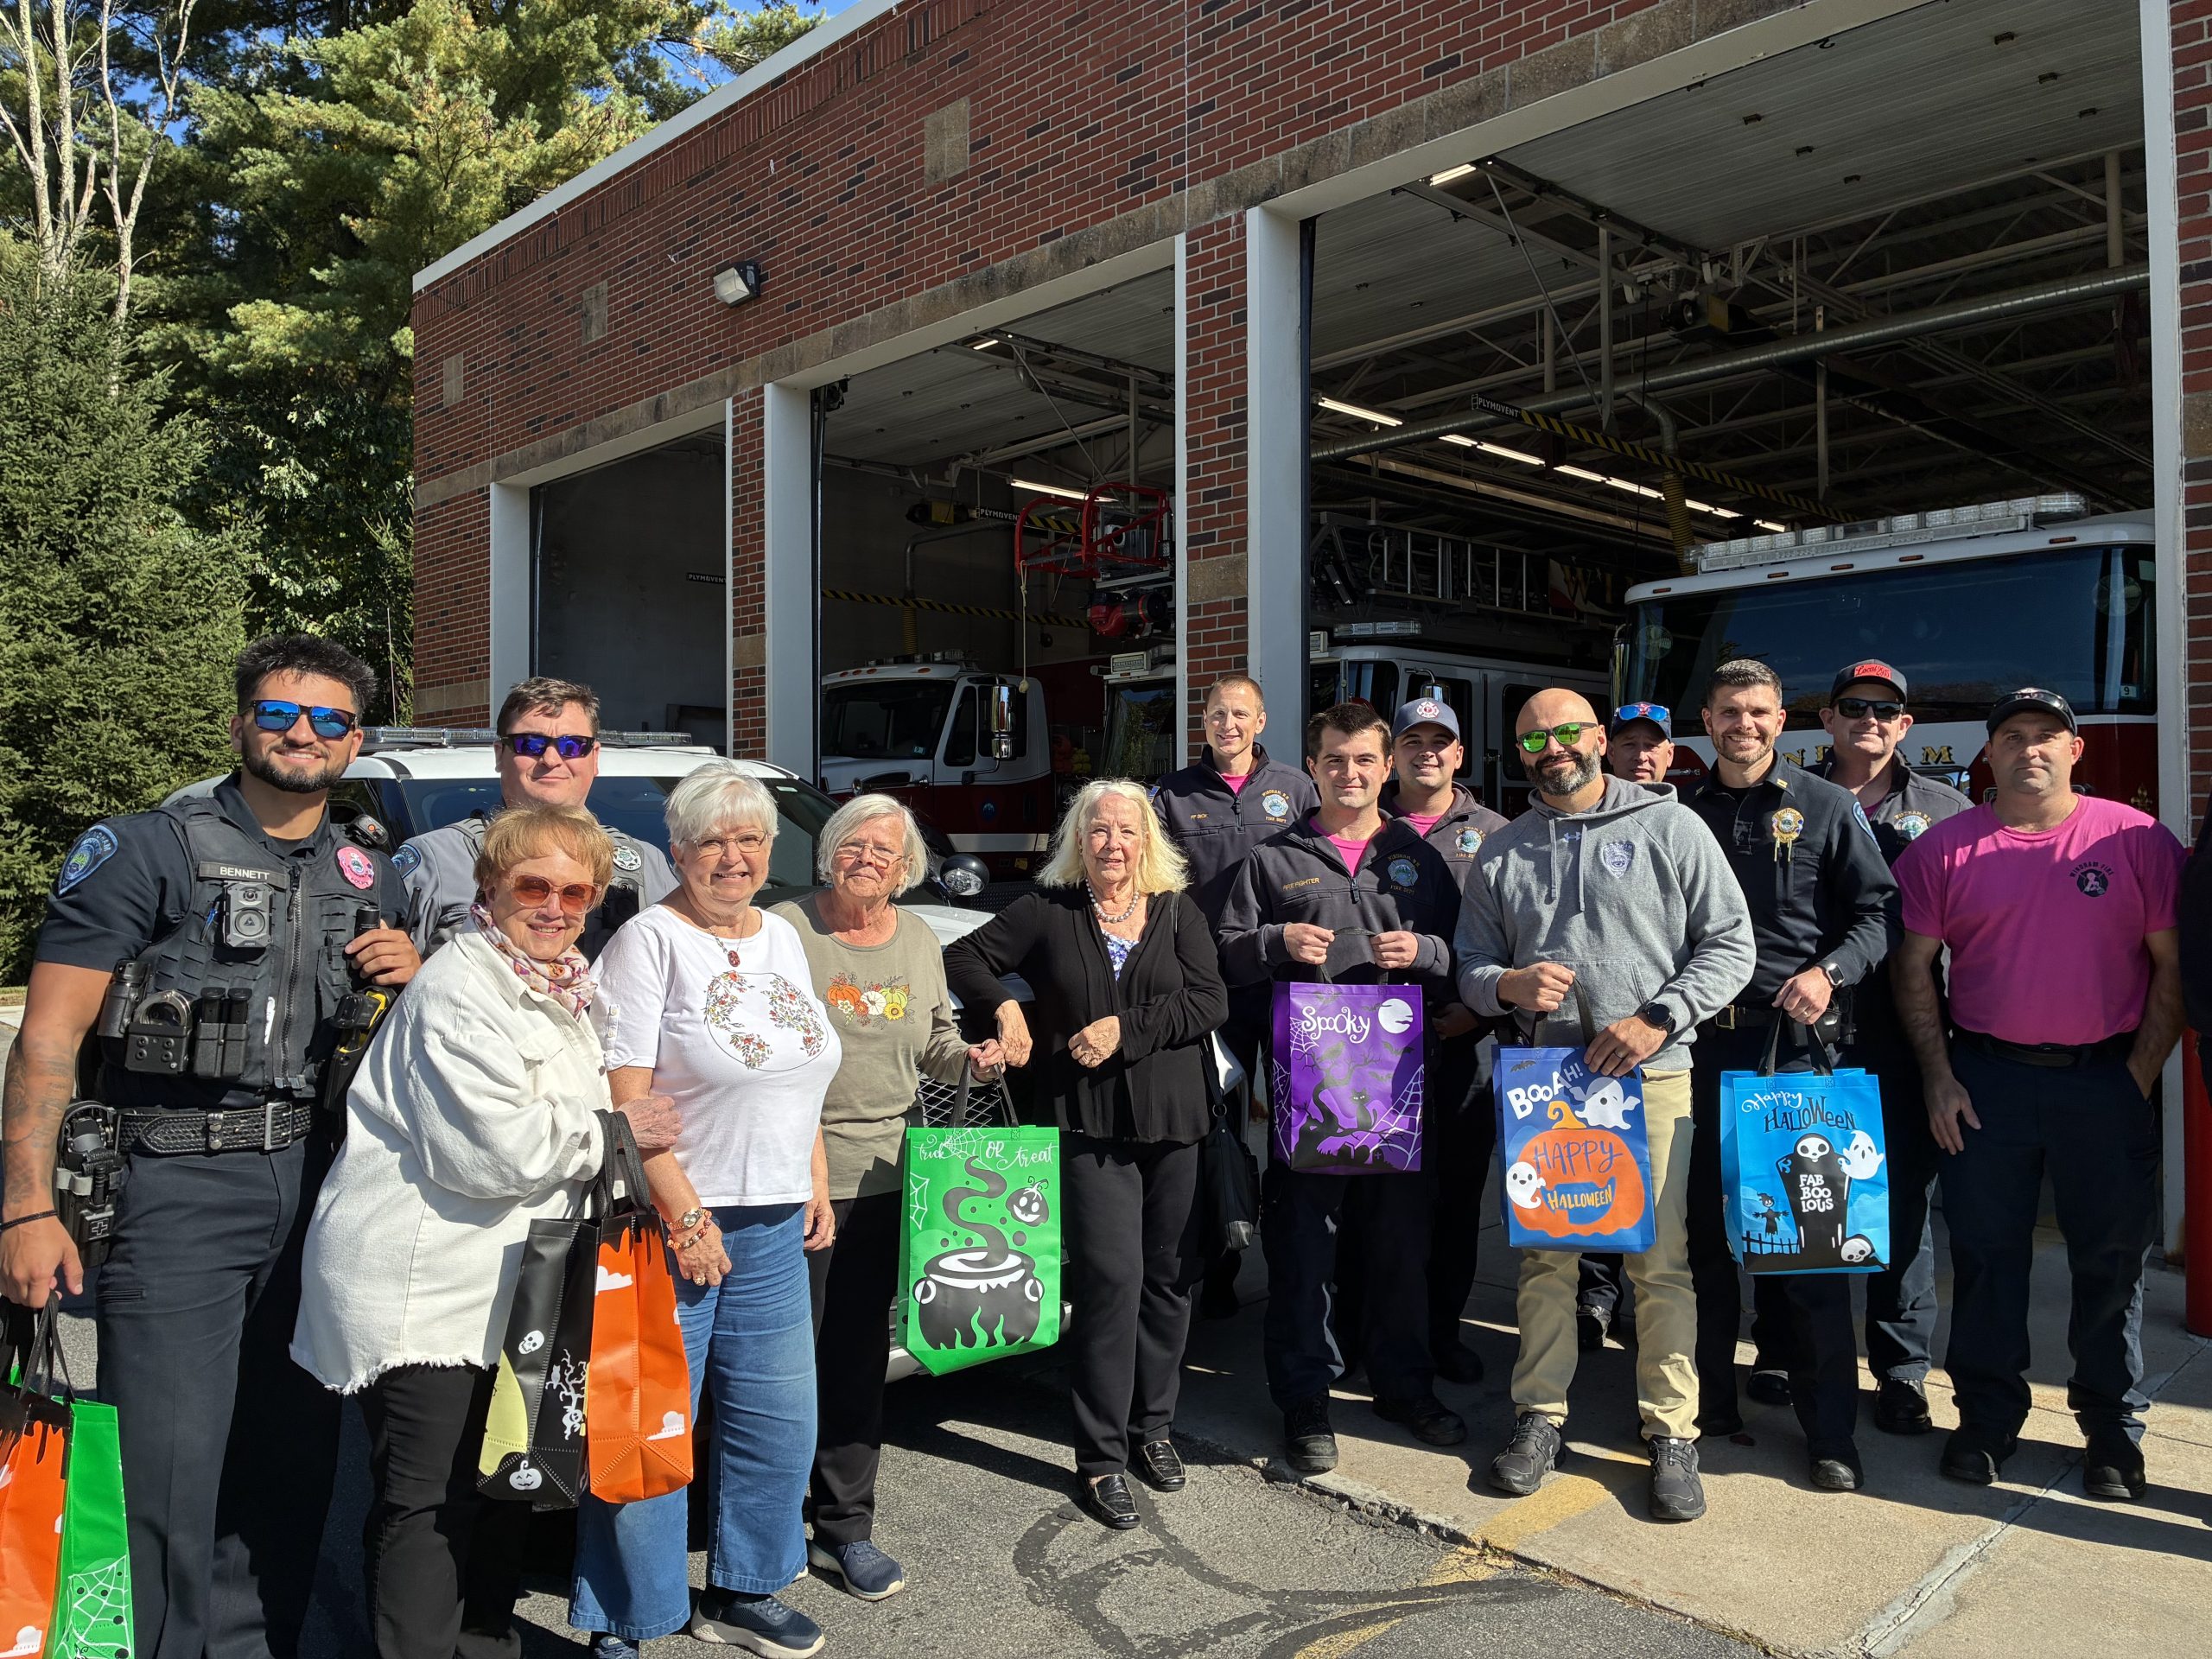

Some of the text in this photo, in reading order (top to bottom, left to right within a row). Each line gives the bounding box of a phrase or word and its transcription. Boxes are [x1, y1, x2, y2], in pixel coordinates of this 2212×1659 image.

[1478, 397, 1519, 418] PLYMOVENT
[2123, 686, 2130, 696] 9
[219, 866, 270, 880] BENNETT
[1301, 1005, 1370, 1044] Spooky
[1741, 1090, 1802, 1113] Happy
[985, 1141, 1006, 1160] OR
[997, 1142, 1059, 1171] treat
[1533, 1140, 1624, 1178] HAPPY
[1799, 1173, 1825, 1187] FAB
[1547, 1184, 1612, 1211] HALLOWEEN
[1800, 1186, 1832, 1200] BOO
